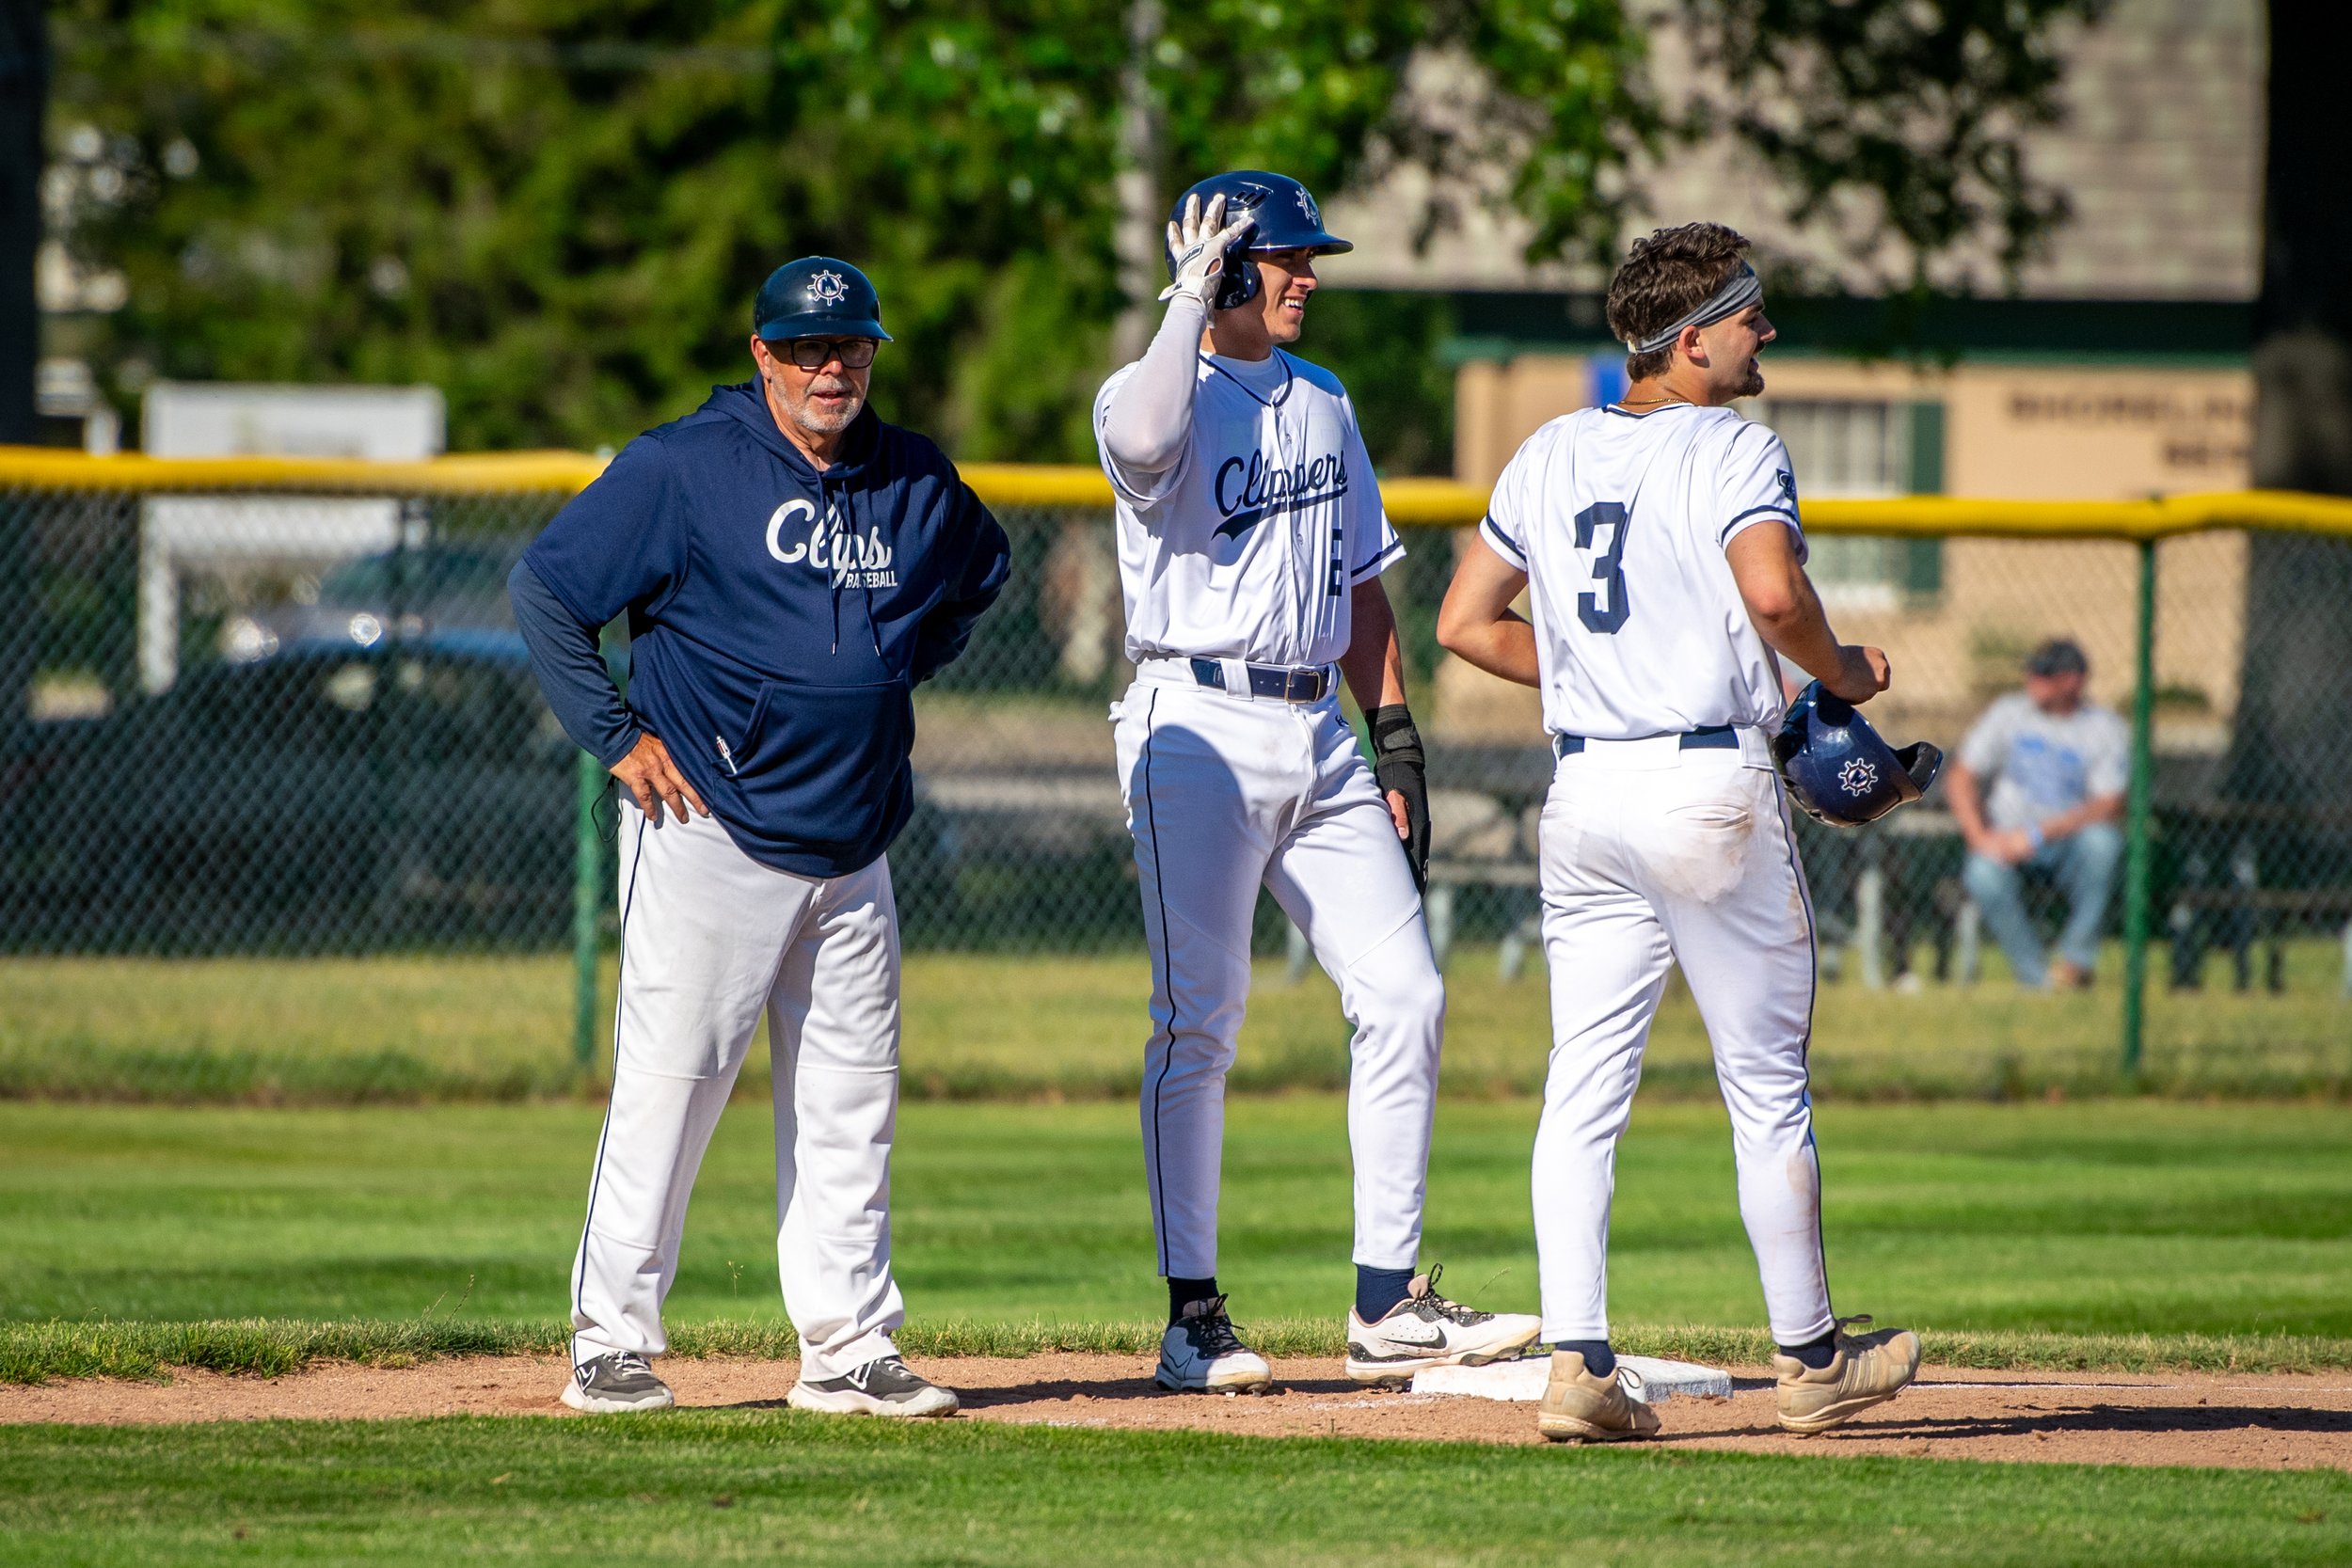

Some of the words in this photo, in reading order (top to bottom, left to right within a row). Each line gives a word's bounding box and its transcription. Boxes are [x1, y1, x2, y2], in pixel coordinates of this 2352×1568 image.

[1215, 448, 1348, 516] Clippers
[766, 499, 892, 589] Clips
[1574, 501, 1630, 635] 3
